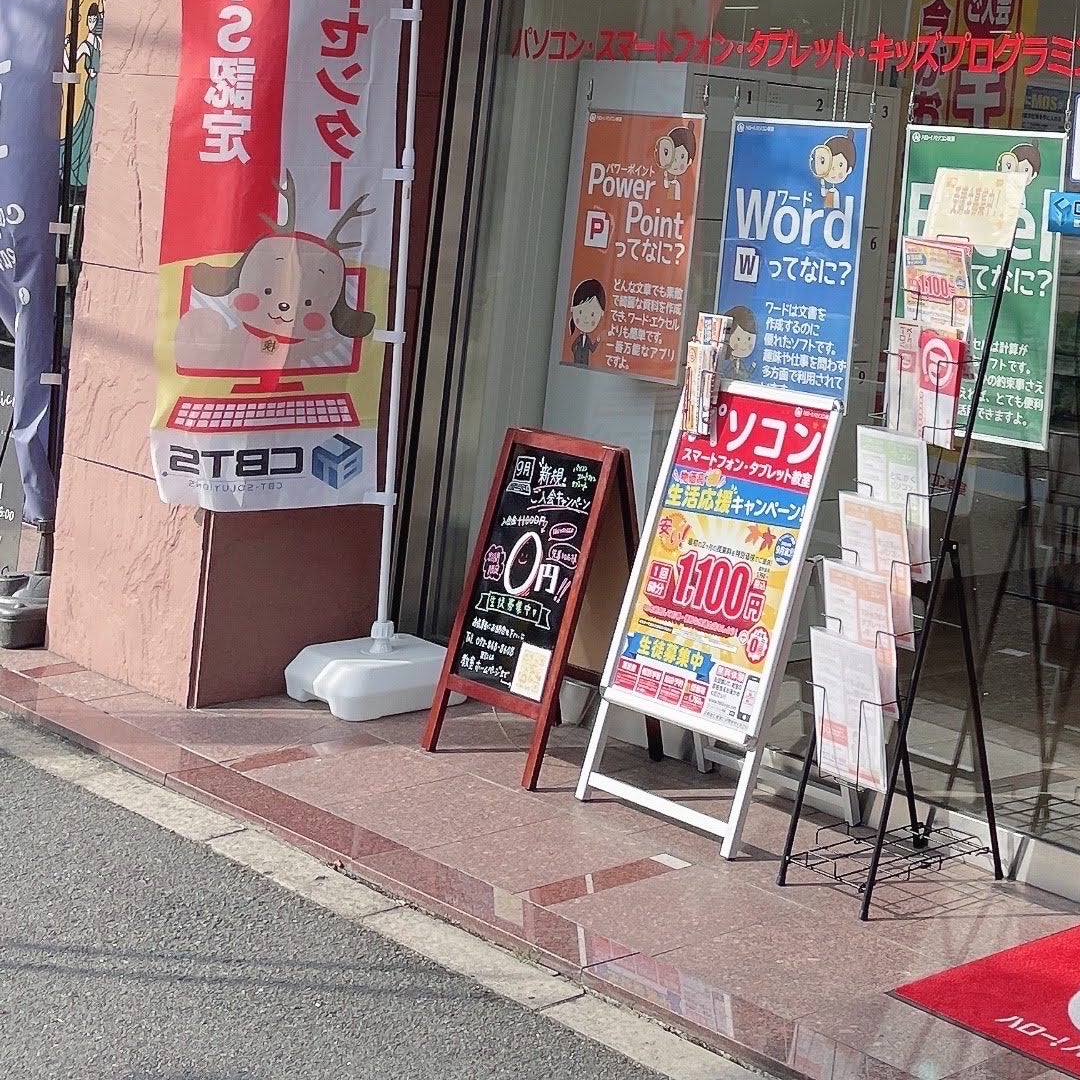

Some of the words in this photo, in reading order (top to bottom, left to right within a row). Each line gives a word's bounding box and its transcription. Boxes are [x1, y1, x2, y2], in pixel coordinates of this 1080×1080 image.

[816, 98, 823, 112] 2
[881, 105, 888, 118] 3
[606, 163, 656, 176] パワーポイント
[587, 163, 656, 200] Power
[777, 190, 813, 207] ワード
[590, 218, 604, 239] P
[625, 201, 684, 240] Point
[736, 188, 854, 250] Word
[615, 238, 686, 265] ってなに?
[869, 237, 877, 250] 6
[739, 253, 756, 276] W
[768, 256, 852, 285] ってなに?
[765, 301, 827, 322] ワードは文書を
[765, 316, 821, 336] 作成するのに
[681, 448, 814, 489] スマートフォン・タブレット教室
